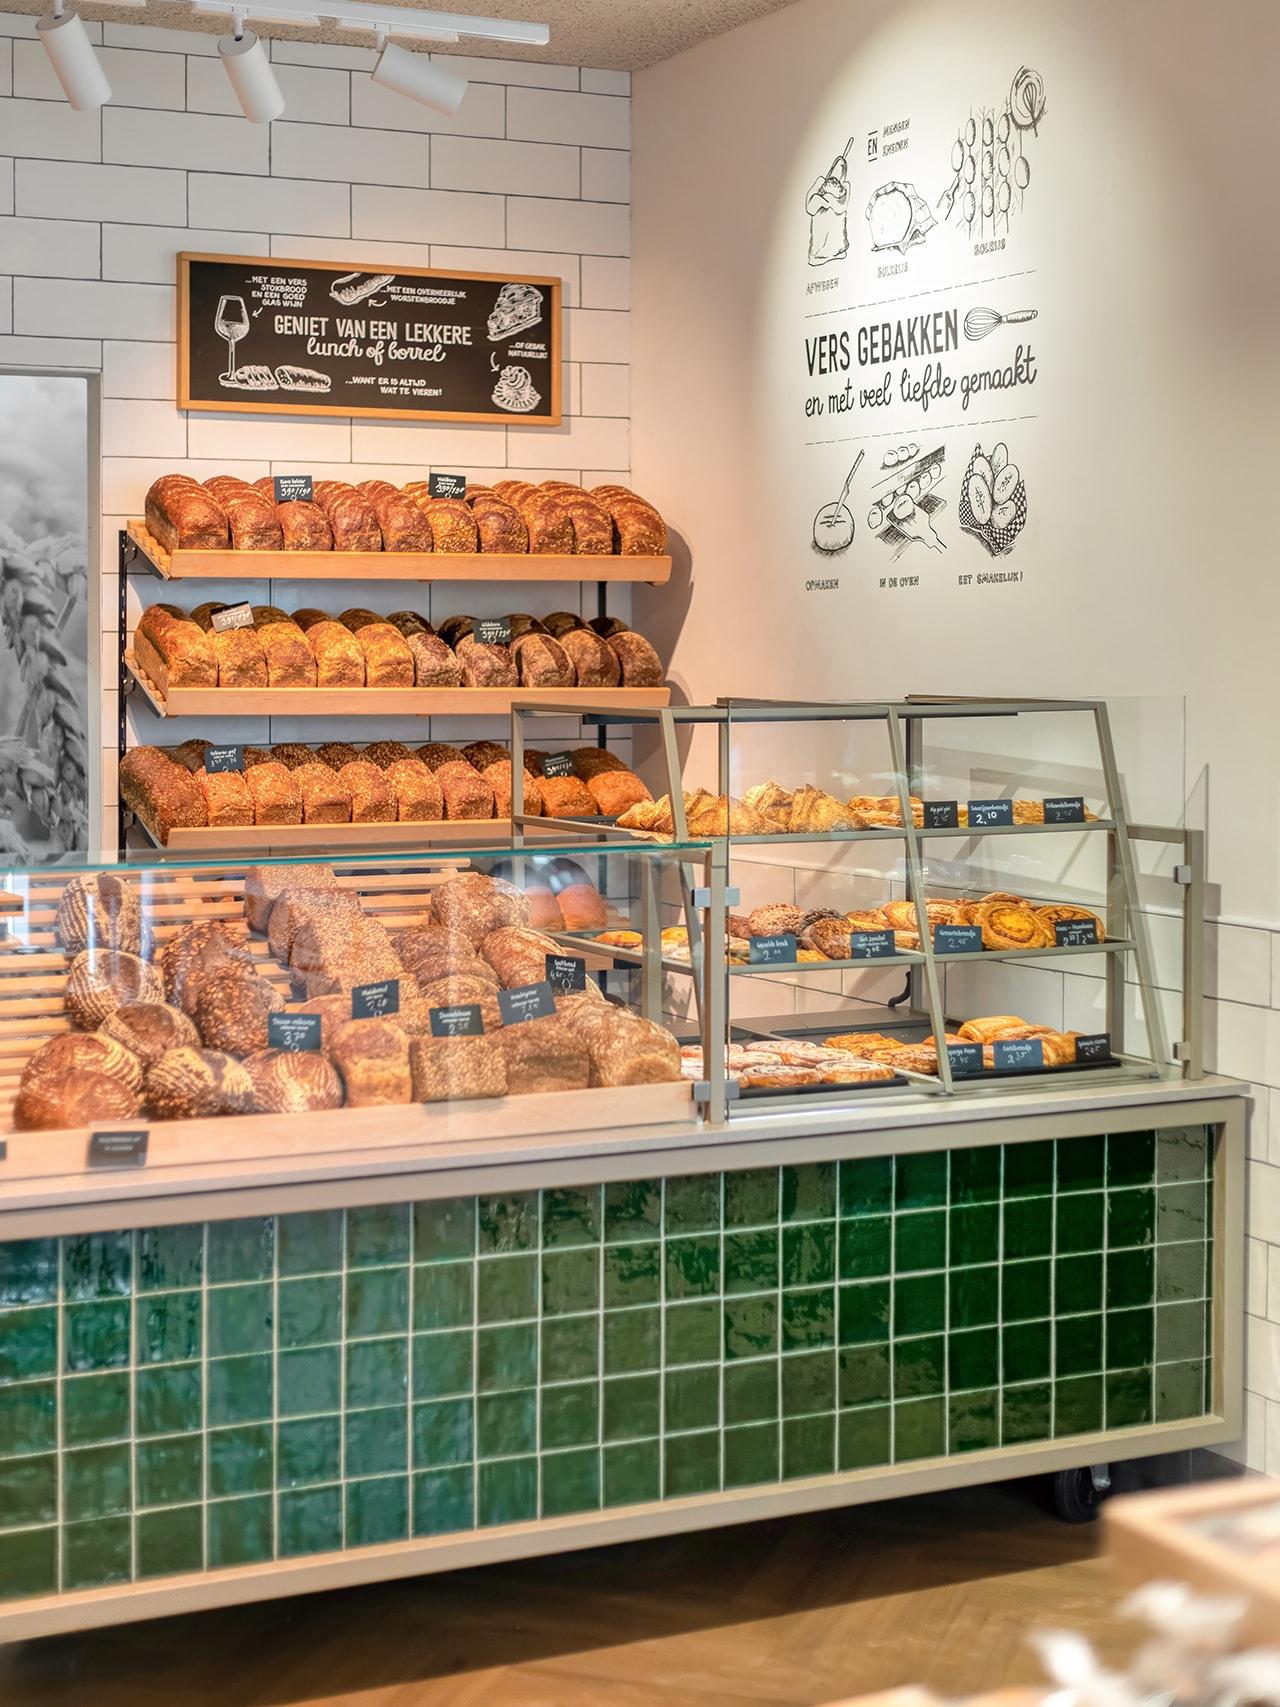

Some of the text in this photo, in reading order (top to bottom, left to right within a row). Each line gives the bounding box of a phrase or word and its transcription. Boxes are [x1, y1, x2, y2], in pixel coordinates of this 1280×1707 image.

[868, 137, 878, 155] EN
[270, 277, 286, 285] EEN
[287, 278, 307, 286] VERS
[261, 284, 307, 294] STOKBROOD
[402, 287, 416, 295] EEN
[417, 288, 467, 298] OVERHEERLIJK
[251, 290, 305, 301] EN EEN GOED
[390, 294, 456, 305] WORSTENBROODJE
[282, 300, 303, 308] WIJN
[274, 314, 472, 345] GENIET VAN EEN LEKKERE
[805, 308, 959, 377] VERS GEBAKKEN
[307, 337, 446, 366] lunch of borrel
[377, 377, 389, 385] ER
[399, 378, 426, 387] ALTIJD
[805, 344, 1038, 417] en met veel liefde gemaakt
[380, 386, 442, 396] WAT TE VIEREN!
[888, 577, 898, 588] DE
[899, 576, 919, 588] OVEN
[958, 574, 973, 586] EET
